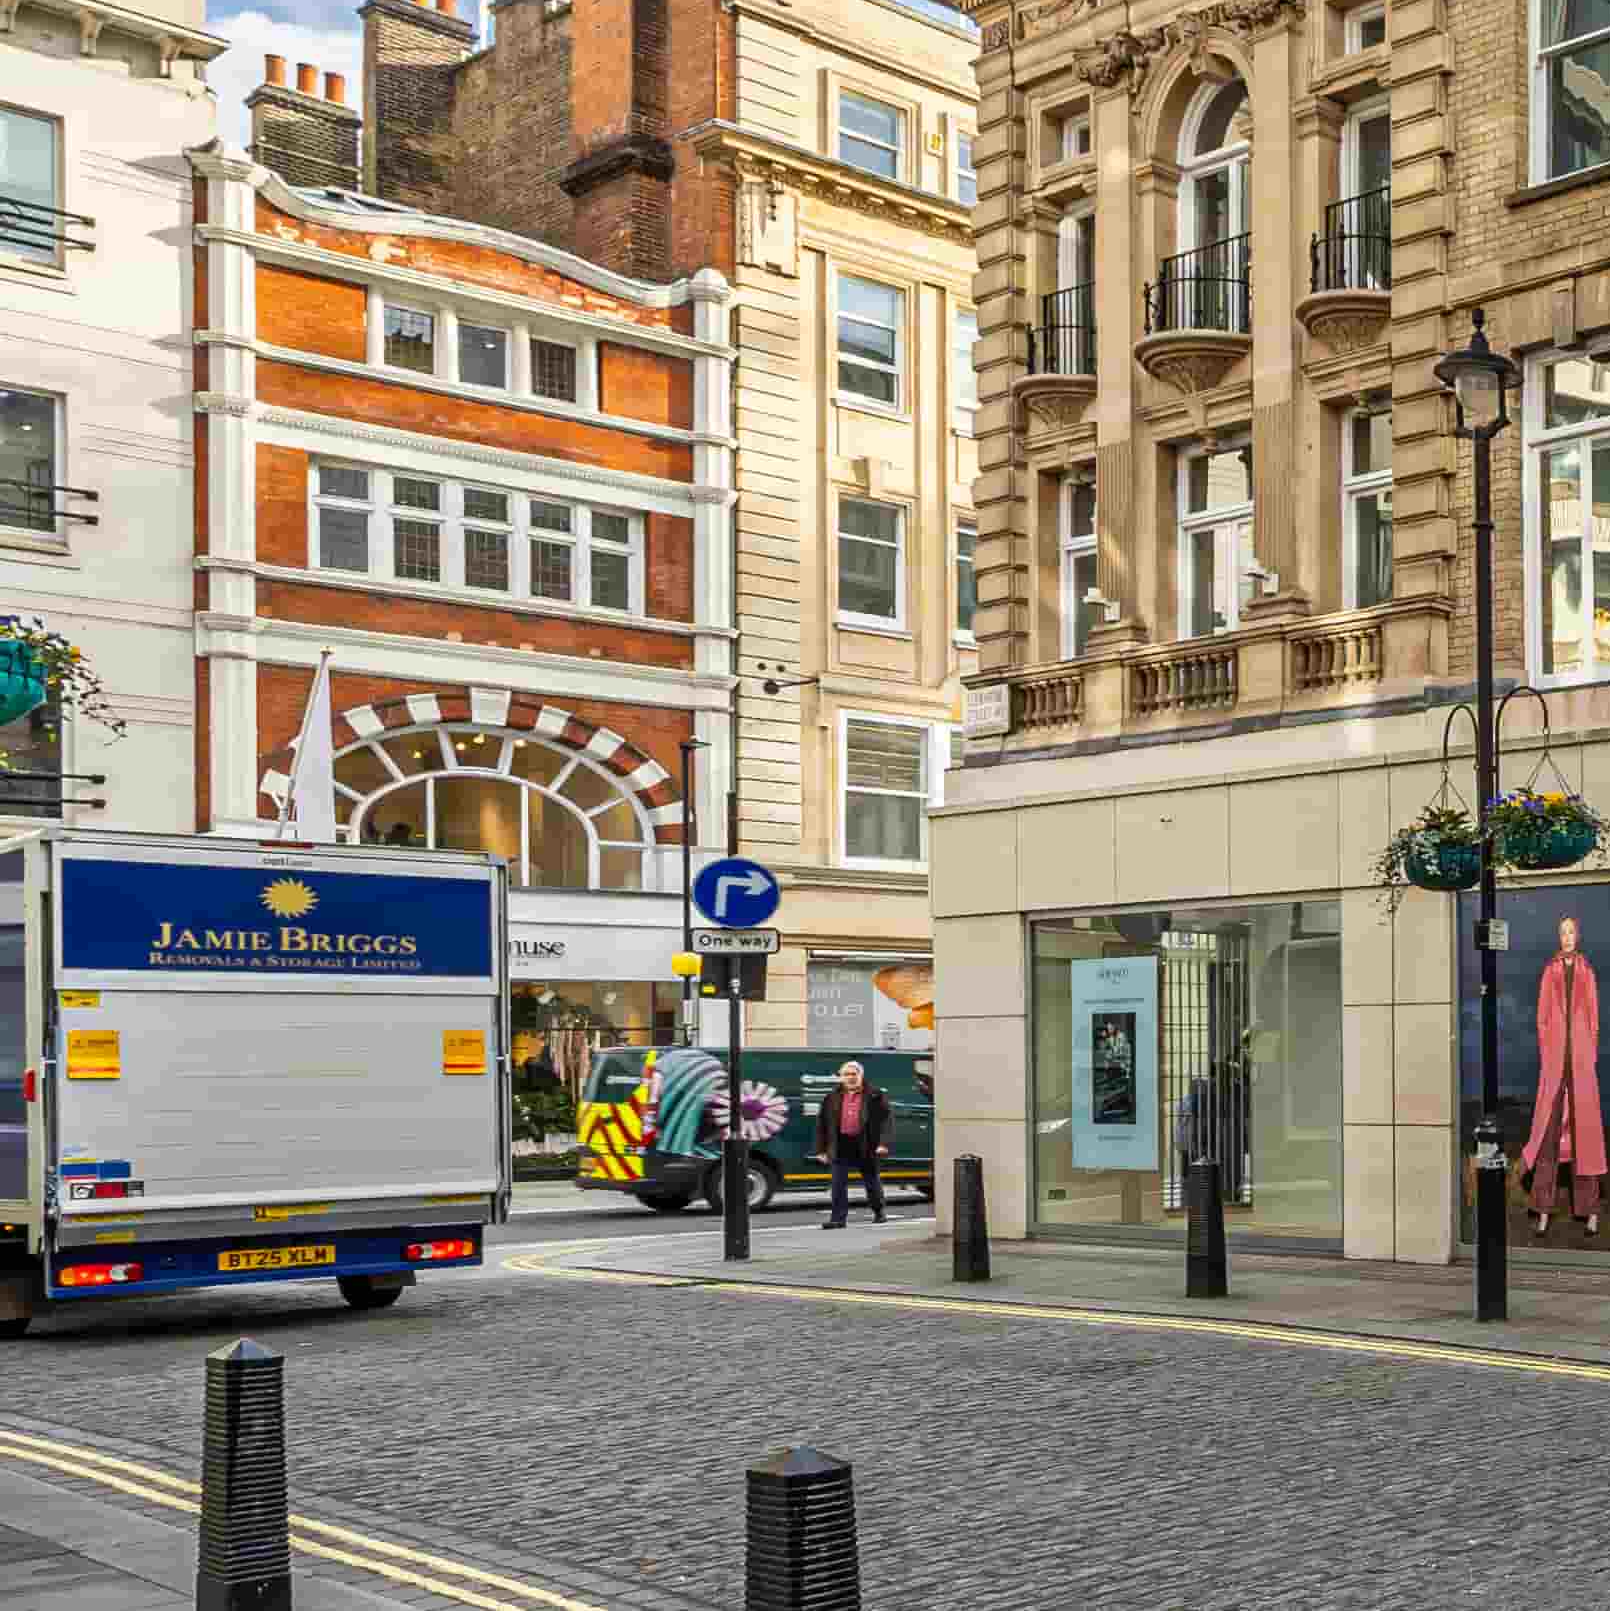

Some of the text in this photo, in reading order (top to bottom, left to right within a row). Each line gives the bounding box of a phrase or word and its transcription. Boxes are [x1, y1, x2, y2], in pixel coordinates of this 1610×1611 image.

[152, 921, 417, 954] JAMIE BRIGGS
[699, 934, 771, 950] One way
